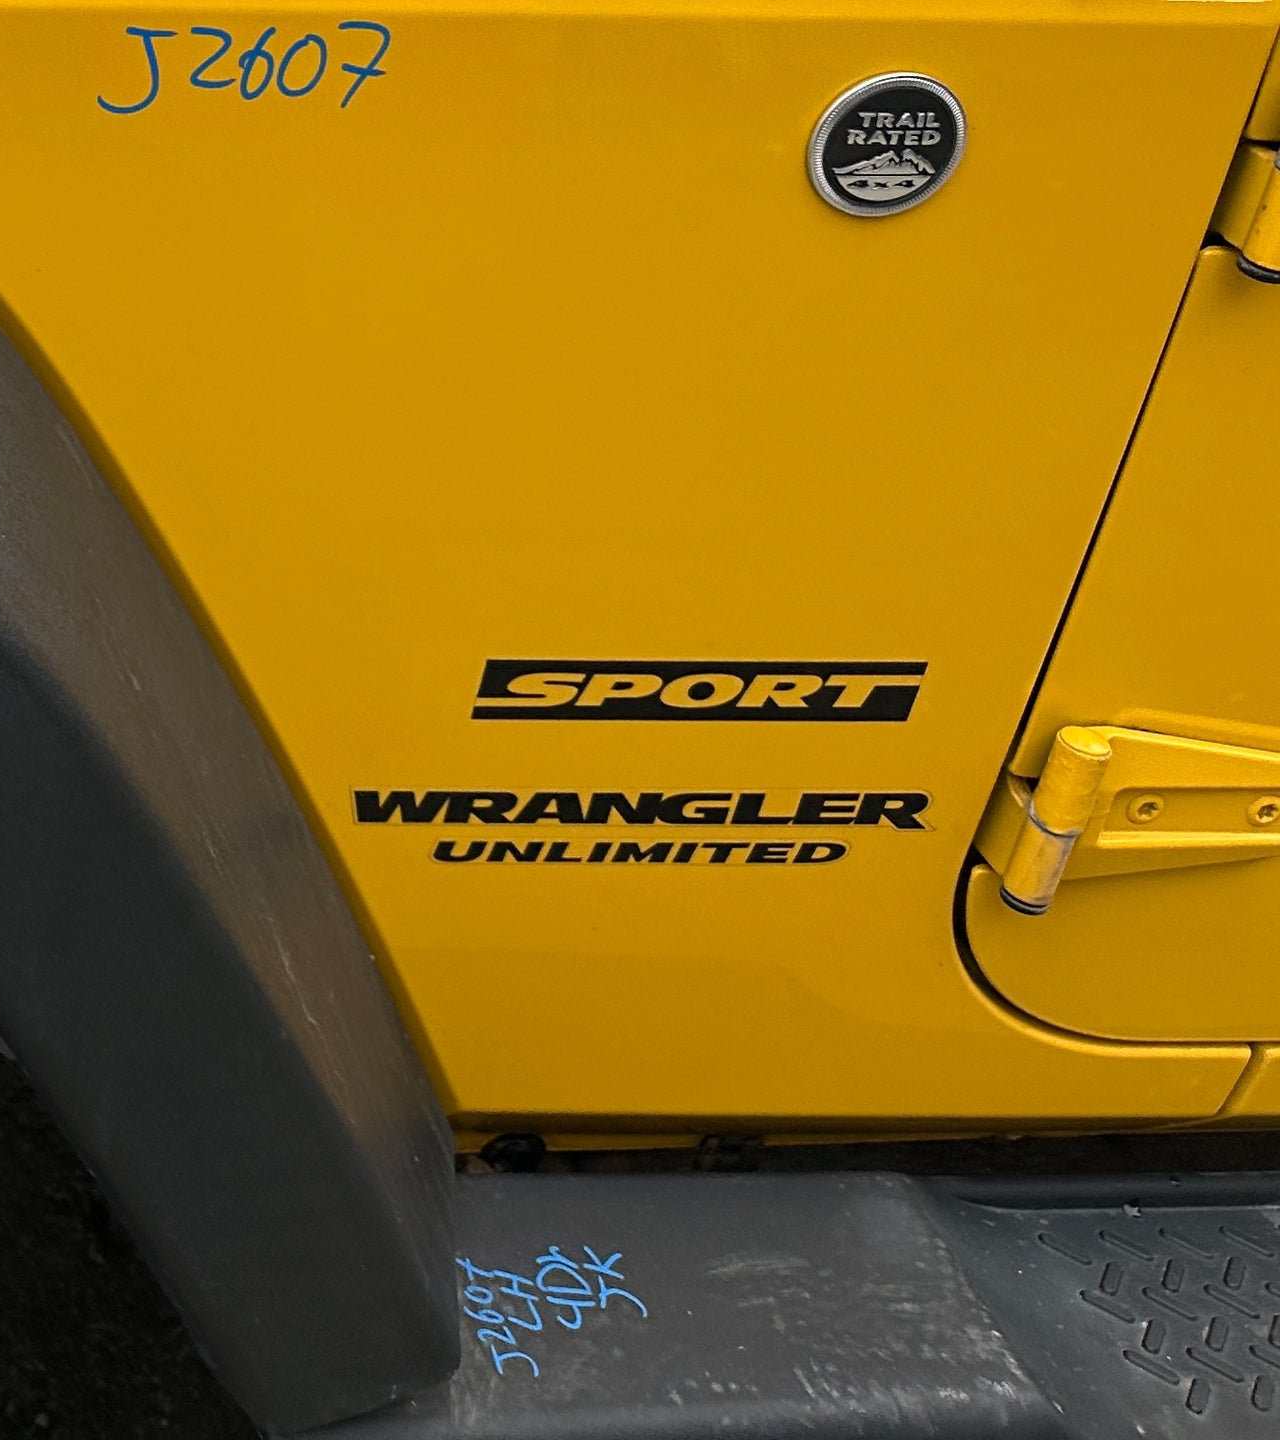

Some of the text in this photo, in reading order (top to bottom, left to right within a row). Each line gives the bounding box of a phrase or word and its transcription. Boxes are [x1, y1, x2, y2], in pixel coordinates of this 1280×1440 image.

[96, 20, 392, 115] J2607
[845, 128, 942, 146] RATED
[857, 111, 941, 129] TRAIL
[475, 670, 926, 710] SPORT
[352, 789, 930, 830] WRANGLER
[431, 840, 849, 864] UNLIMITED
[582, 1244, 648, 1318] JK
[454, 1256, 541, 1378] J2607
